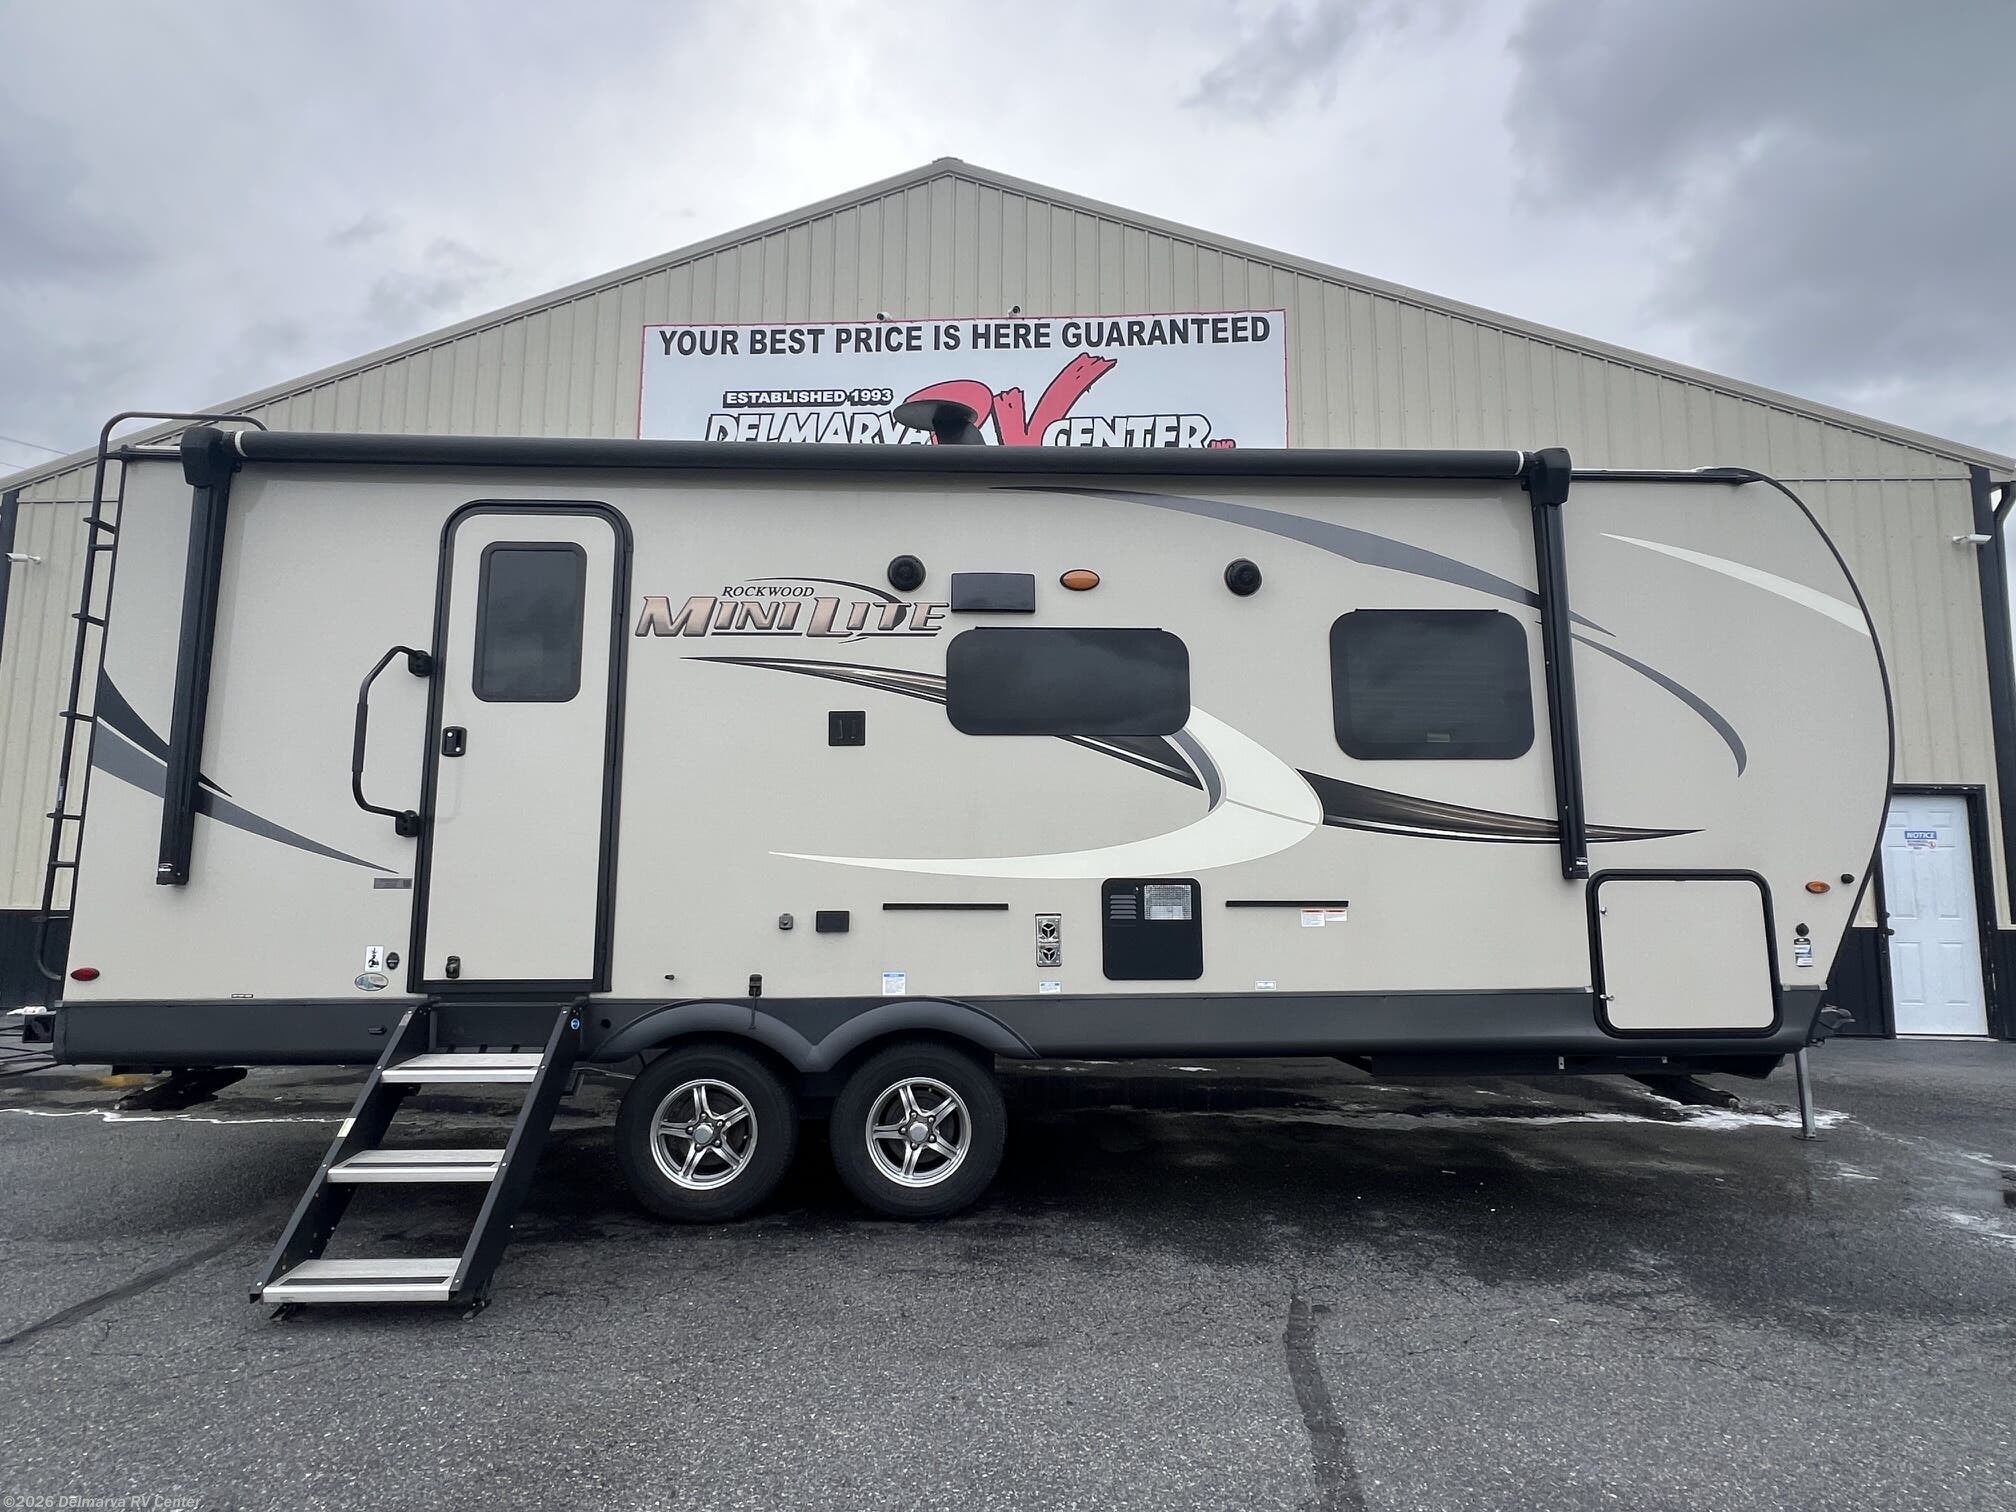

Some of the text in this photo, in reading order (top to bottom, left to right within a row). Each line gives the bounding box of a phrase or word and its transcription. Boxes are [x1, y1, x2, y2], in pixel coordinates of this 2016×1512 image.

[659, 316, 1270, 356] YOUR BEST PRICE IS HERE GUARANTEED
[725, 389, 893, 405] ESTABLISHED 1993
[1041, 414, 1211, 448] CENTER
[722, 586, 815, 598] ROCKWOOD
[635, 596, 950, 638] MINI LITE
